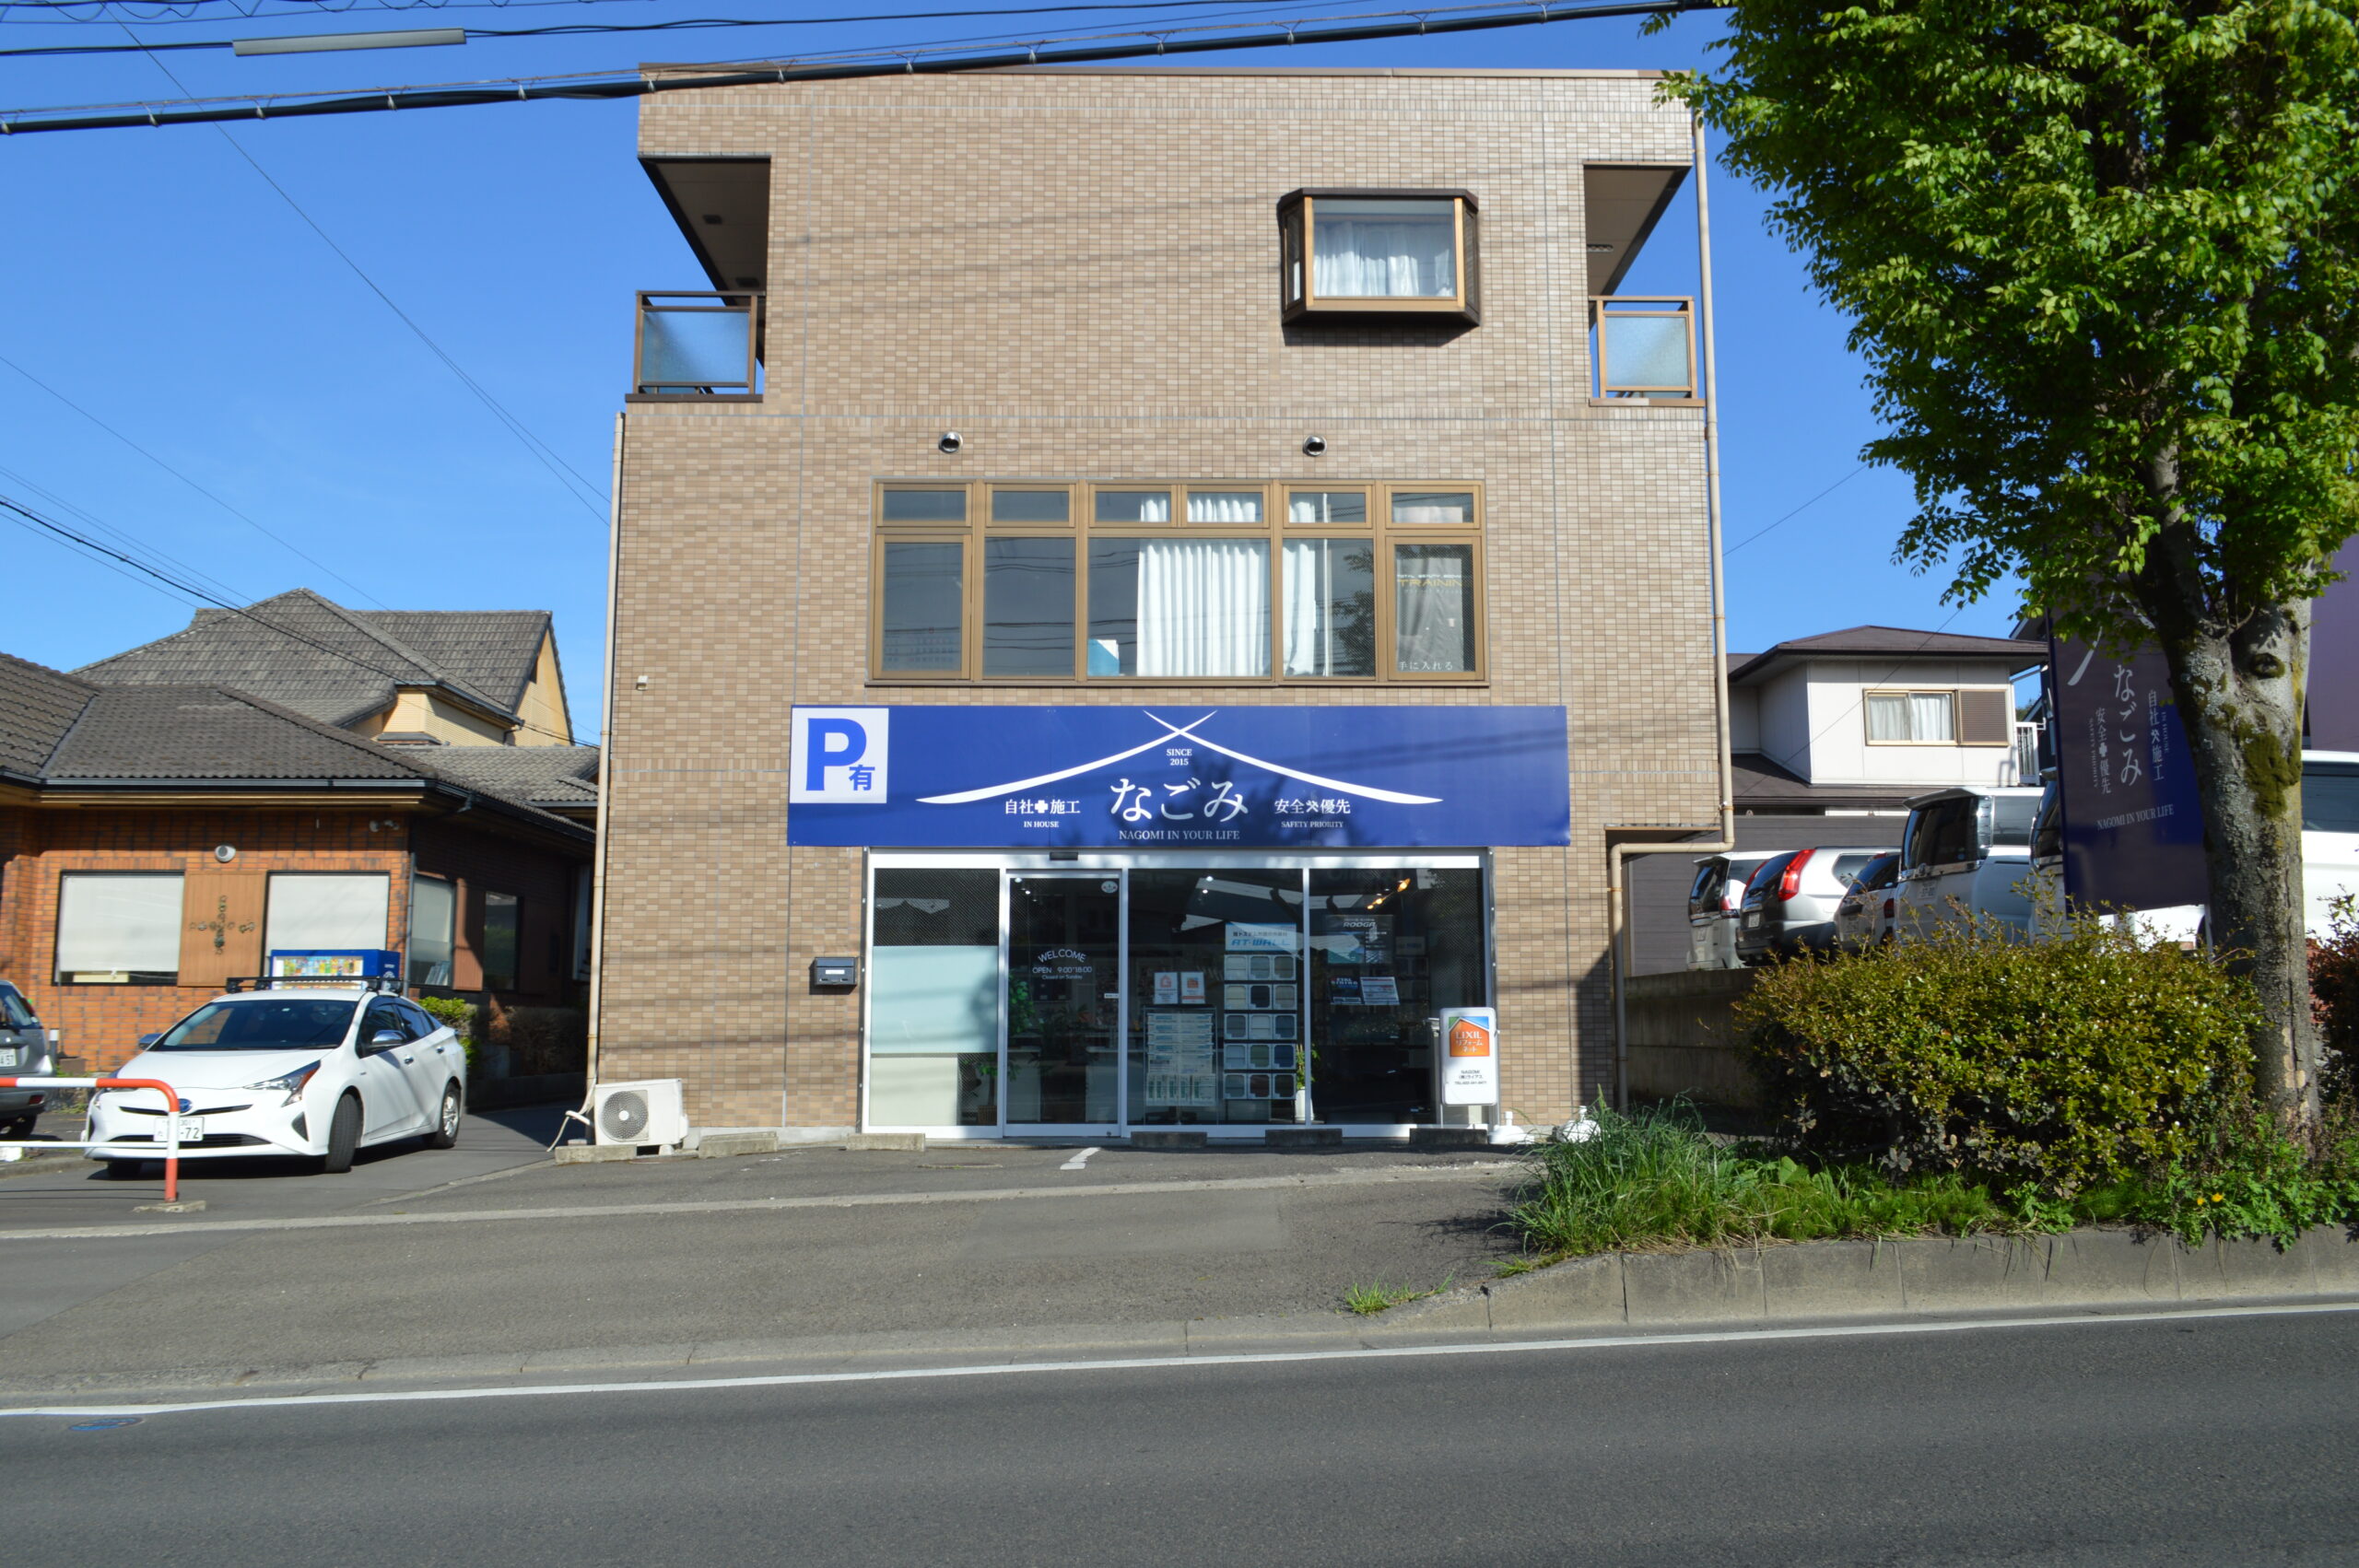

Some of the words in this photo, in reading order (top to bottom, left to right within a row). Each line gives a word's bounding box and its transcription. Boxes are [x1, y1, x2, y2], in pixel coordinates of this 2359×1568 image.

[1399, 661, 1453, 671] 手に入れる
[2113, 664, 2142, 787] なごみ
[806, 718, 867, 791] P
[1166, 748, 1192, 756] SINCE
[1169, 758, 1189, 766] 2015
[849, 764, 875, 791] 有
[1109, 777, 1249, 823] なごみ
[2096, 815, 2125, 830] NAGOMI
[2125, 813, 2135, 825] IN
[2136, 807, 2157, 822] YOUR
[2157, 803, 2175, 817] LIFE
[1119, 830, 1164, 840] NAGOMI
[1168, 830, 1180, 840] IN
[1182, 830, 1213, 840] YOUR
[1215, 830, 1240, 840] LIFE
[1038, 948, 1087, 963] WELCOME
[1455, 1031, 1483, 1039] LIXIL
